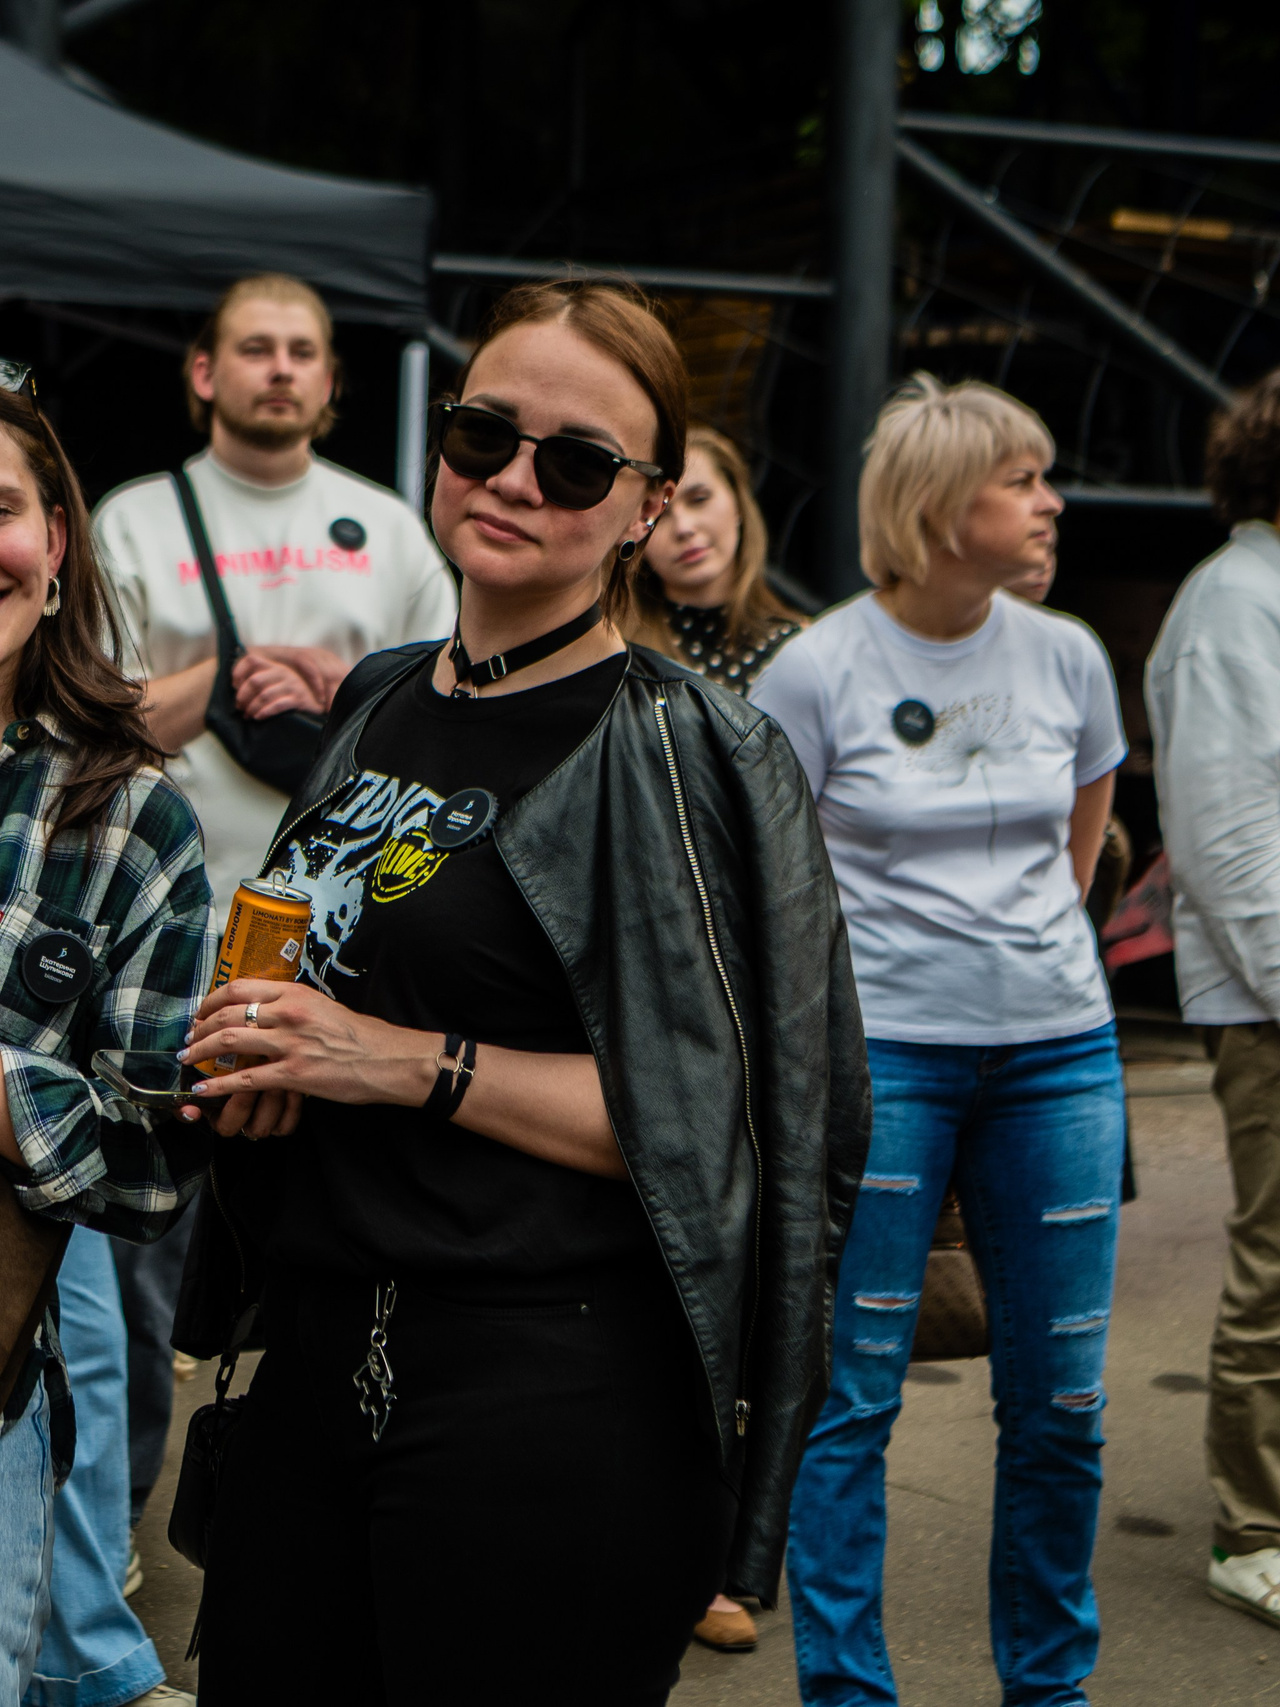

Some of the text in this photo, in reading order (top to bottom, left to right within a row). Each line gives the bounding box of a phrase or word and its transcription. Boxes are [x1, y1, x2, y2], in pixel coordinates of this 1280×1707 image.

[177, 546, 372, 586] MNIMALISM
[227, 903, 243, 950] BORJOMI
[253, 909, 285, 922] LIMONATI
[41, 956, 76, 973] Екатерина
